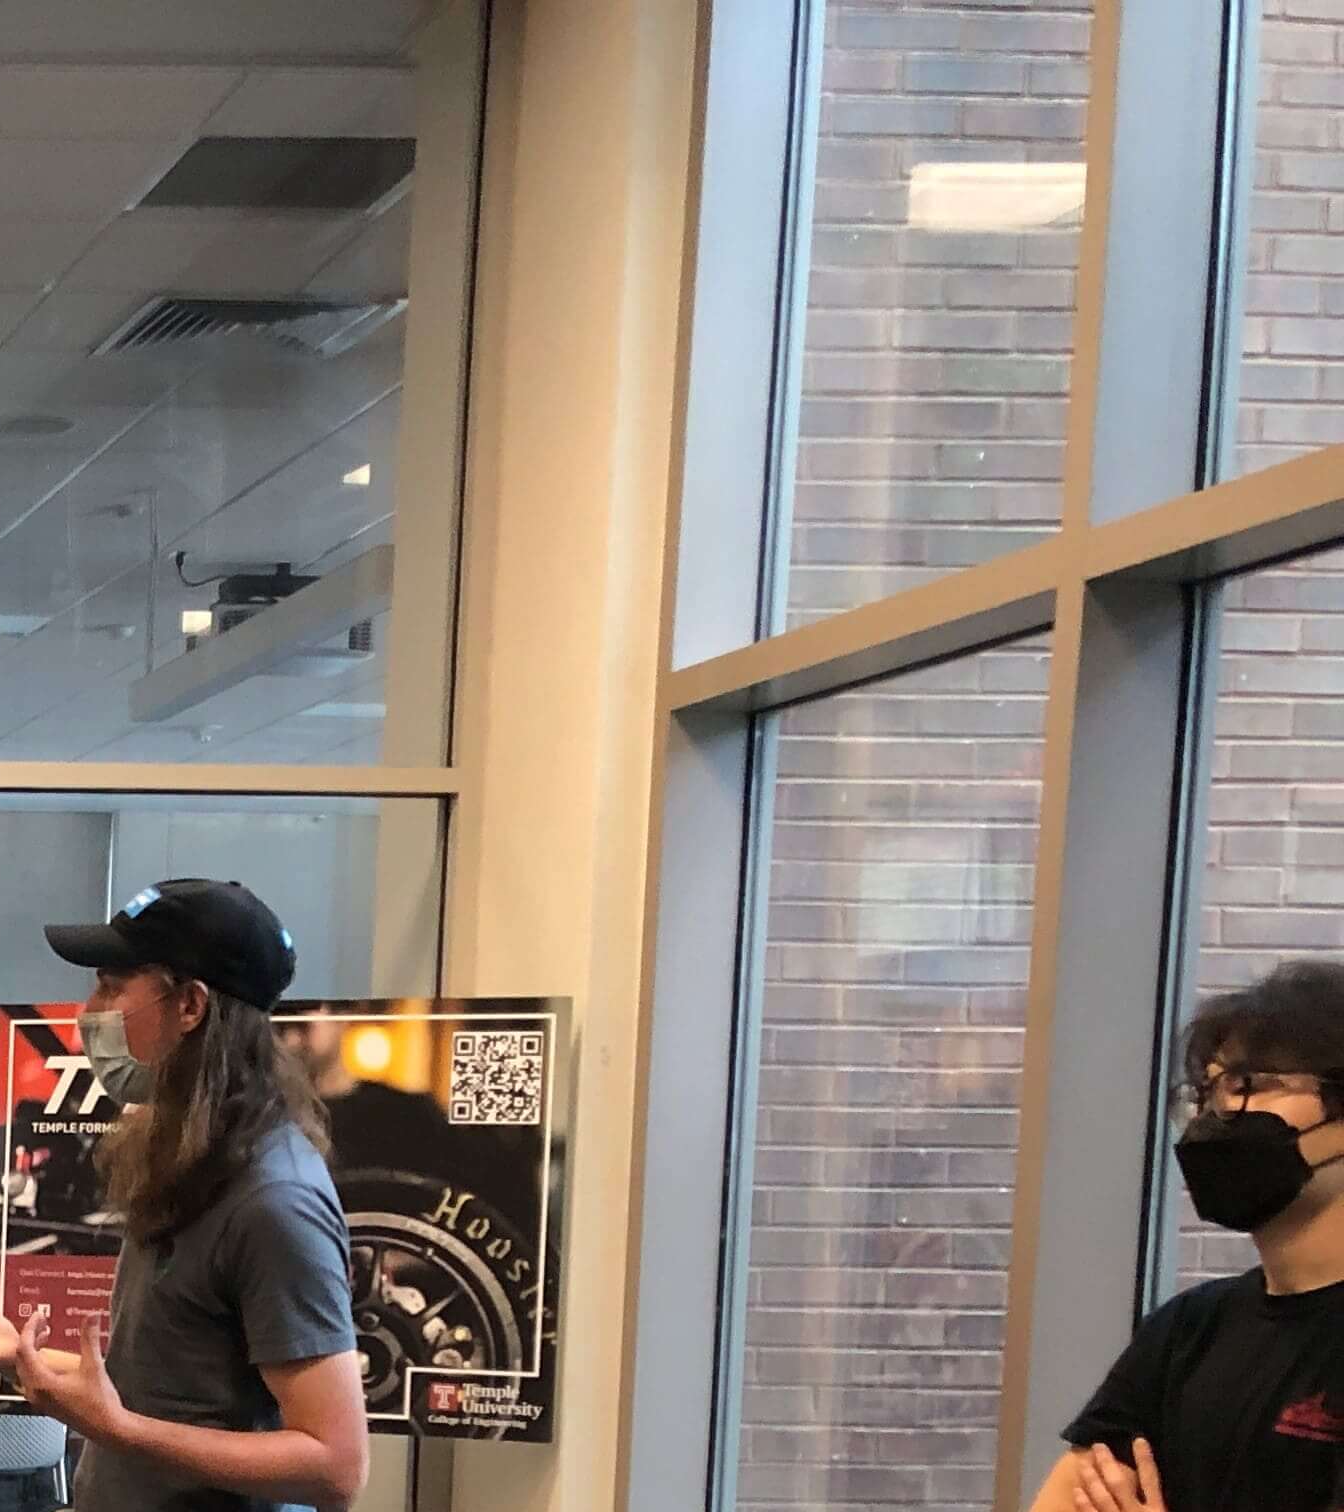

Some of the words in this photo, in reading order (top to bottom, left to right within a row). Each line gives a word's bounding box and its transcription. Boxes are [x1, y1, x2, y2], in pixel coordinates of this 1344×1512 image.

[32, 1122, 78, 1134] TEMPLE
[79, 1122, 124, 1134] FORMU
[433, 1385, 455, 1409] T
[462, 1383, 520, 1402] Temple
[462, 1399, 544, 1420] University
